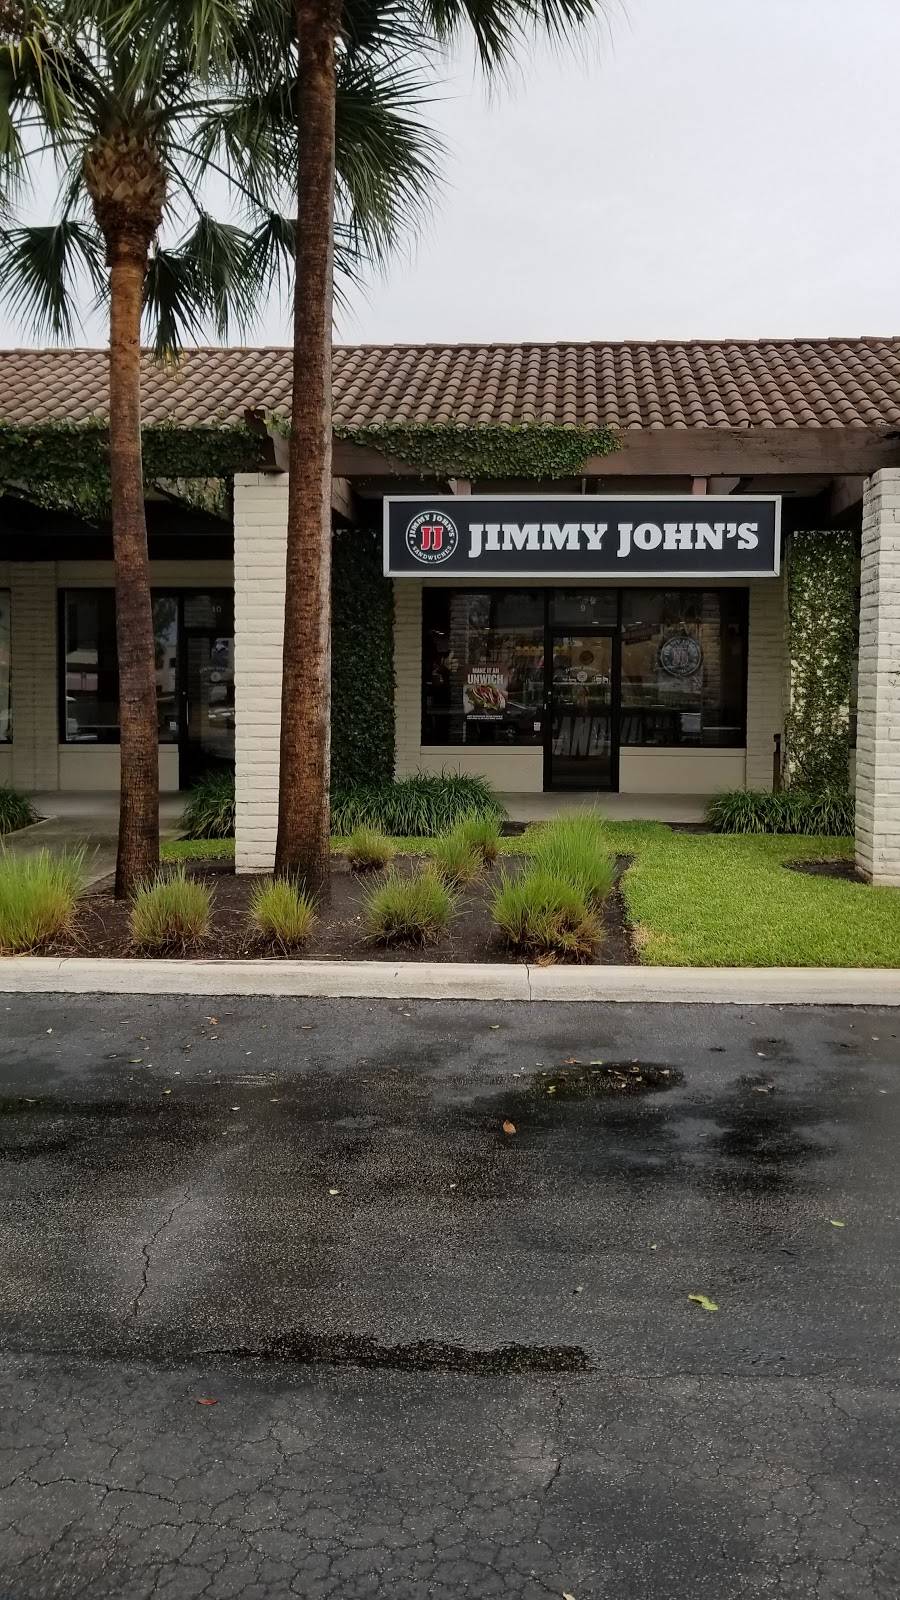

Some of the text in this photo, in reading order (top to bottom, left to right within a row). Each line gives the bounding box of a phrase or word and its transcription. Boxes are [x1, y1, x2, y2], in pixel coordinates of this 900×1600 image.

[409, 514, 455, 538] JIMMY JOHN'S
[420, 525, 443, 551] JJ
[468, 522, 759, 558] JIMMY JOHN'S
[412, 546, 452, 561] SANDWICHES
[467, 674, 504, 685] UNWICH
